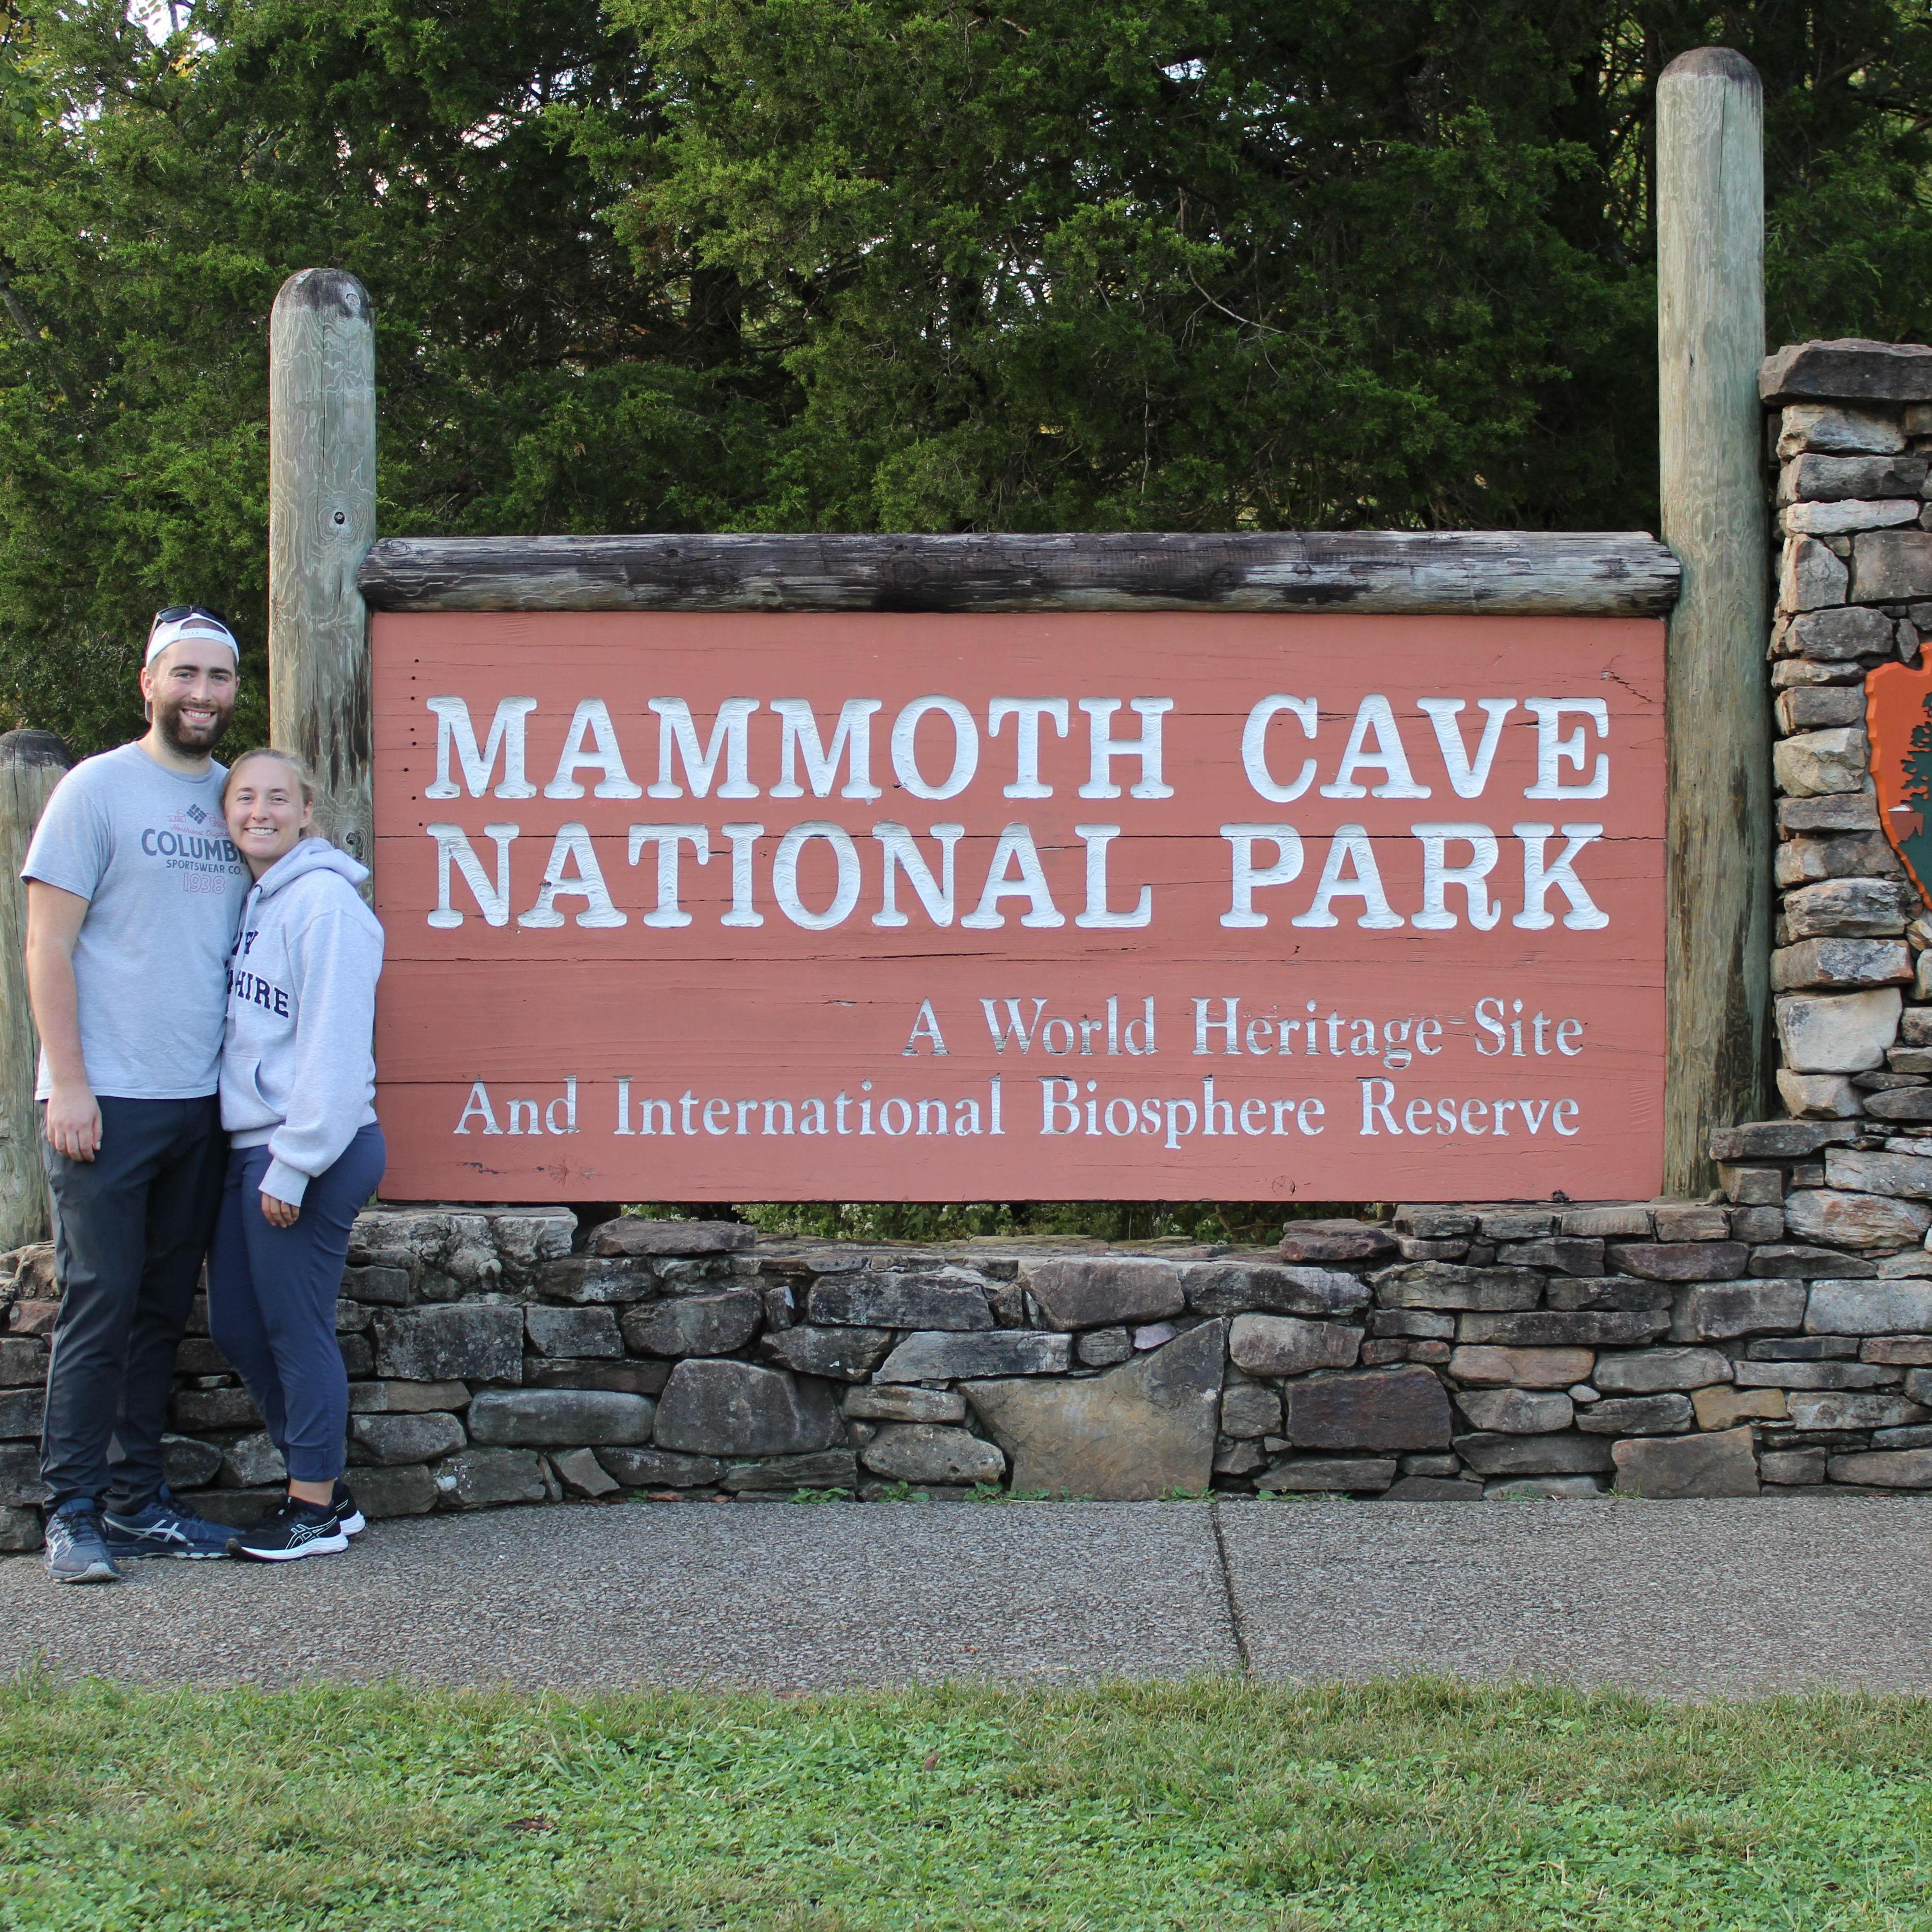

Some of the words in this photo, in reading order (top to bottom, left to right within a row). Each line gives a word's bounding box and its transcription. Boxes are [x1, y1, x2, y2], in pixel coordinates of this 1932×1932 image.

[425, 693, 1175, 802] MAMMOTH
[1240, 693, 1610, 803] CAVE
[142, 828, 245, 863] COLUMBI
[166, 859, 225, 874] SPORTSWEAR
[228, 865, 242, 875] CO.
[427, 820, 1153, 931] NATIONAL
[1219, 821, 1611, 931] PARK
[182, 872, 225, 894] 1938
[228, 968, 289, 1019] HIRE
[901, 996, 952, 1057] A
[979, 994, 1159, 1056] World
[1191, 996, 1443, 1070] Heritage
[1474, 996, 1584, 1056] Site
[453, 1076, 581, 1136] And
[613, 1073, 1006, 1136] International
[1036, 1074, 1326, 1151] Biosphere
[1355, 1076, 1580, 1136] Reserve
